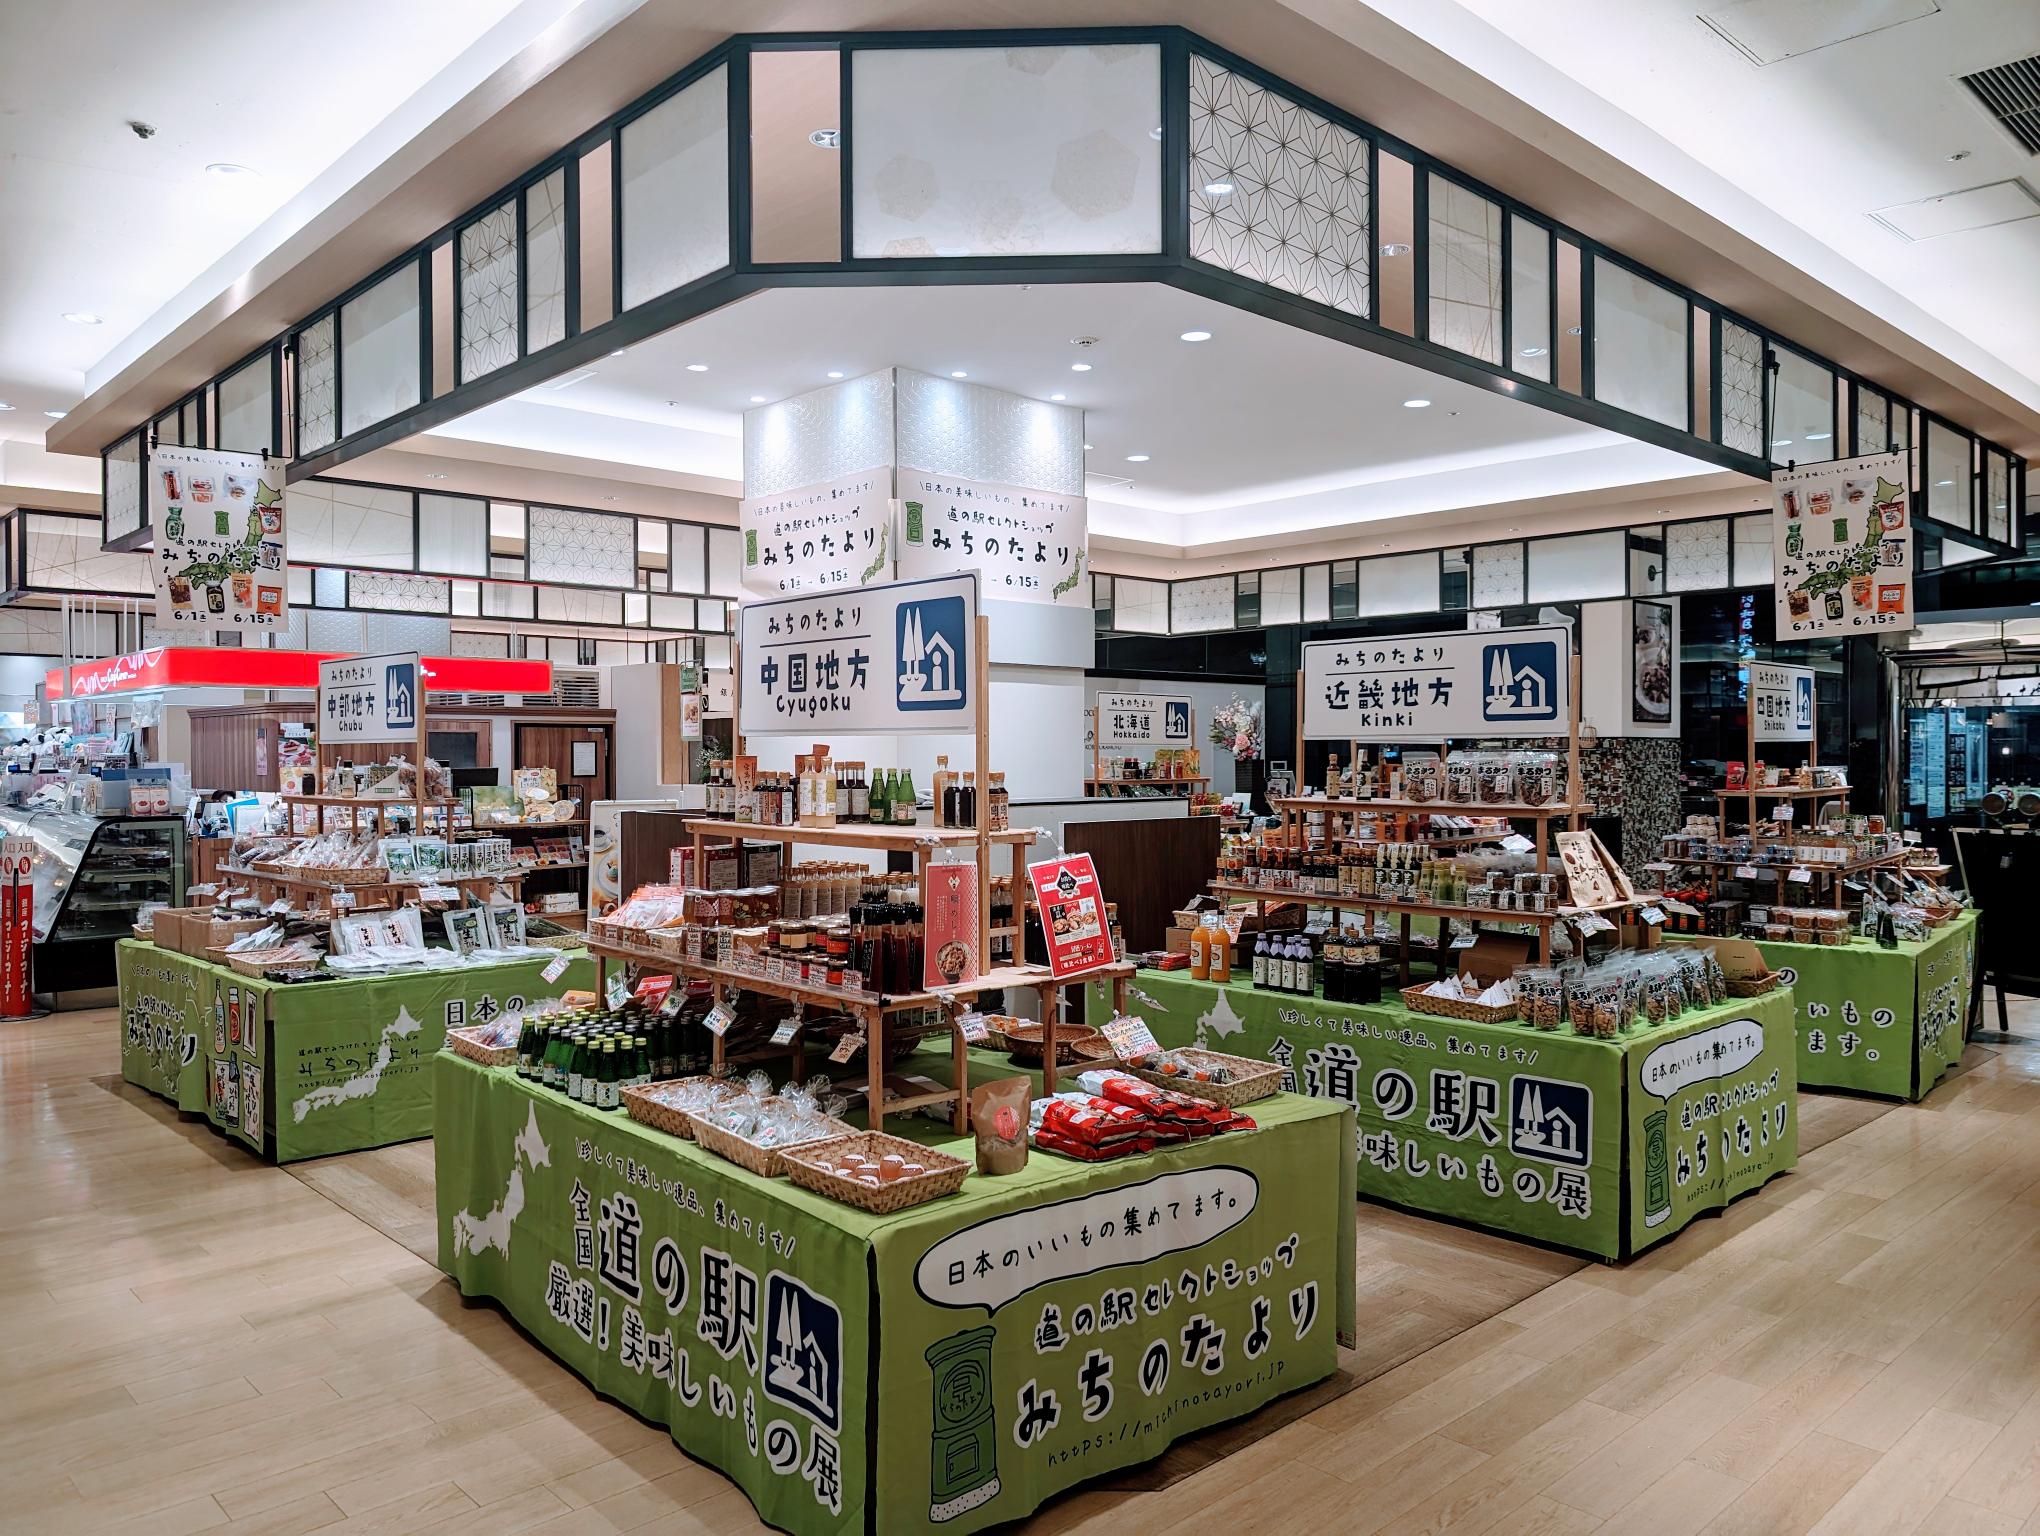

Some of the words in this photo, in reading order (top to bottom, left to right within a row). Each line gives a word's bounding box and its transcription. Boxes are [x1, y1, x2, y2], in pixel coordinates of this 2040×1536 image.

[774, 506, 860, 536] 道の駅セレクトショップ
[947, 505, 1055, 534] 道の駅セレクトショップ
[163, 549, 280, 567] みちのたより
[764, 527, 874, 565] みちのたより
[933, 529, 1068, 565] みちのたより
[1783, 553, 1903, 576] みちのたより
[768, 606, 861, 634] みちのたより
[1335, 647, 1444, 666] みちのたより
[332, 667, 372, 682] みちのたより
[761, 648, 870, 695] 中国地方
[328, 692, 375, 719] 中部地方
[776, 692, 851, 718] Cyugoku
[1111, 698, 1153, 708] みちのたより
[1325, 677, 1453, 709] 近畿地方
[1757, 695, 1791, 718] 四国地方
[339, 720, 363, 731] Chubu
[1114, 714, 1150, 730] 北海道
[1361, 711, 1413, 726] Kinki
[1764, 719, 1786, 730] Shikoku
[1113, 730, 1150, 739] Hokkaido
[18, 842, 32, 852] 入口
[447, 997, 524, 1025] 日本の
[299, 1048, 418, 1077] みちのたより
[1305, 1046, 1499, 1143] 道の駅
[1357, 1133, 1589, 1214] 味しいもの展
[570, 1180, 593, 1267] 全国
[948, 1188, 1236, 1286] 日本のいいもの集めてます。
[600, 1197, 758, 1370] 道の駅
[1036, 1233, 1299, 1350] 道の駅セレクトショップ
[1018, 1282, 1317, 1444] みちのたより
[1048, 1359, 1286, 1467] https://michinotayori.jp
